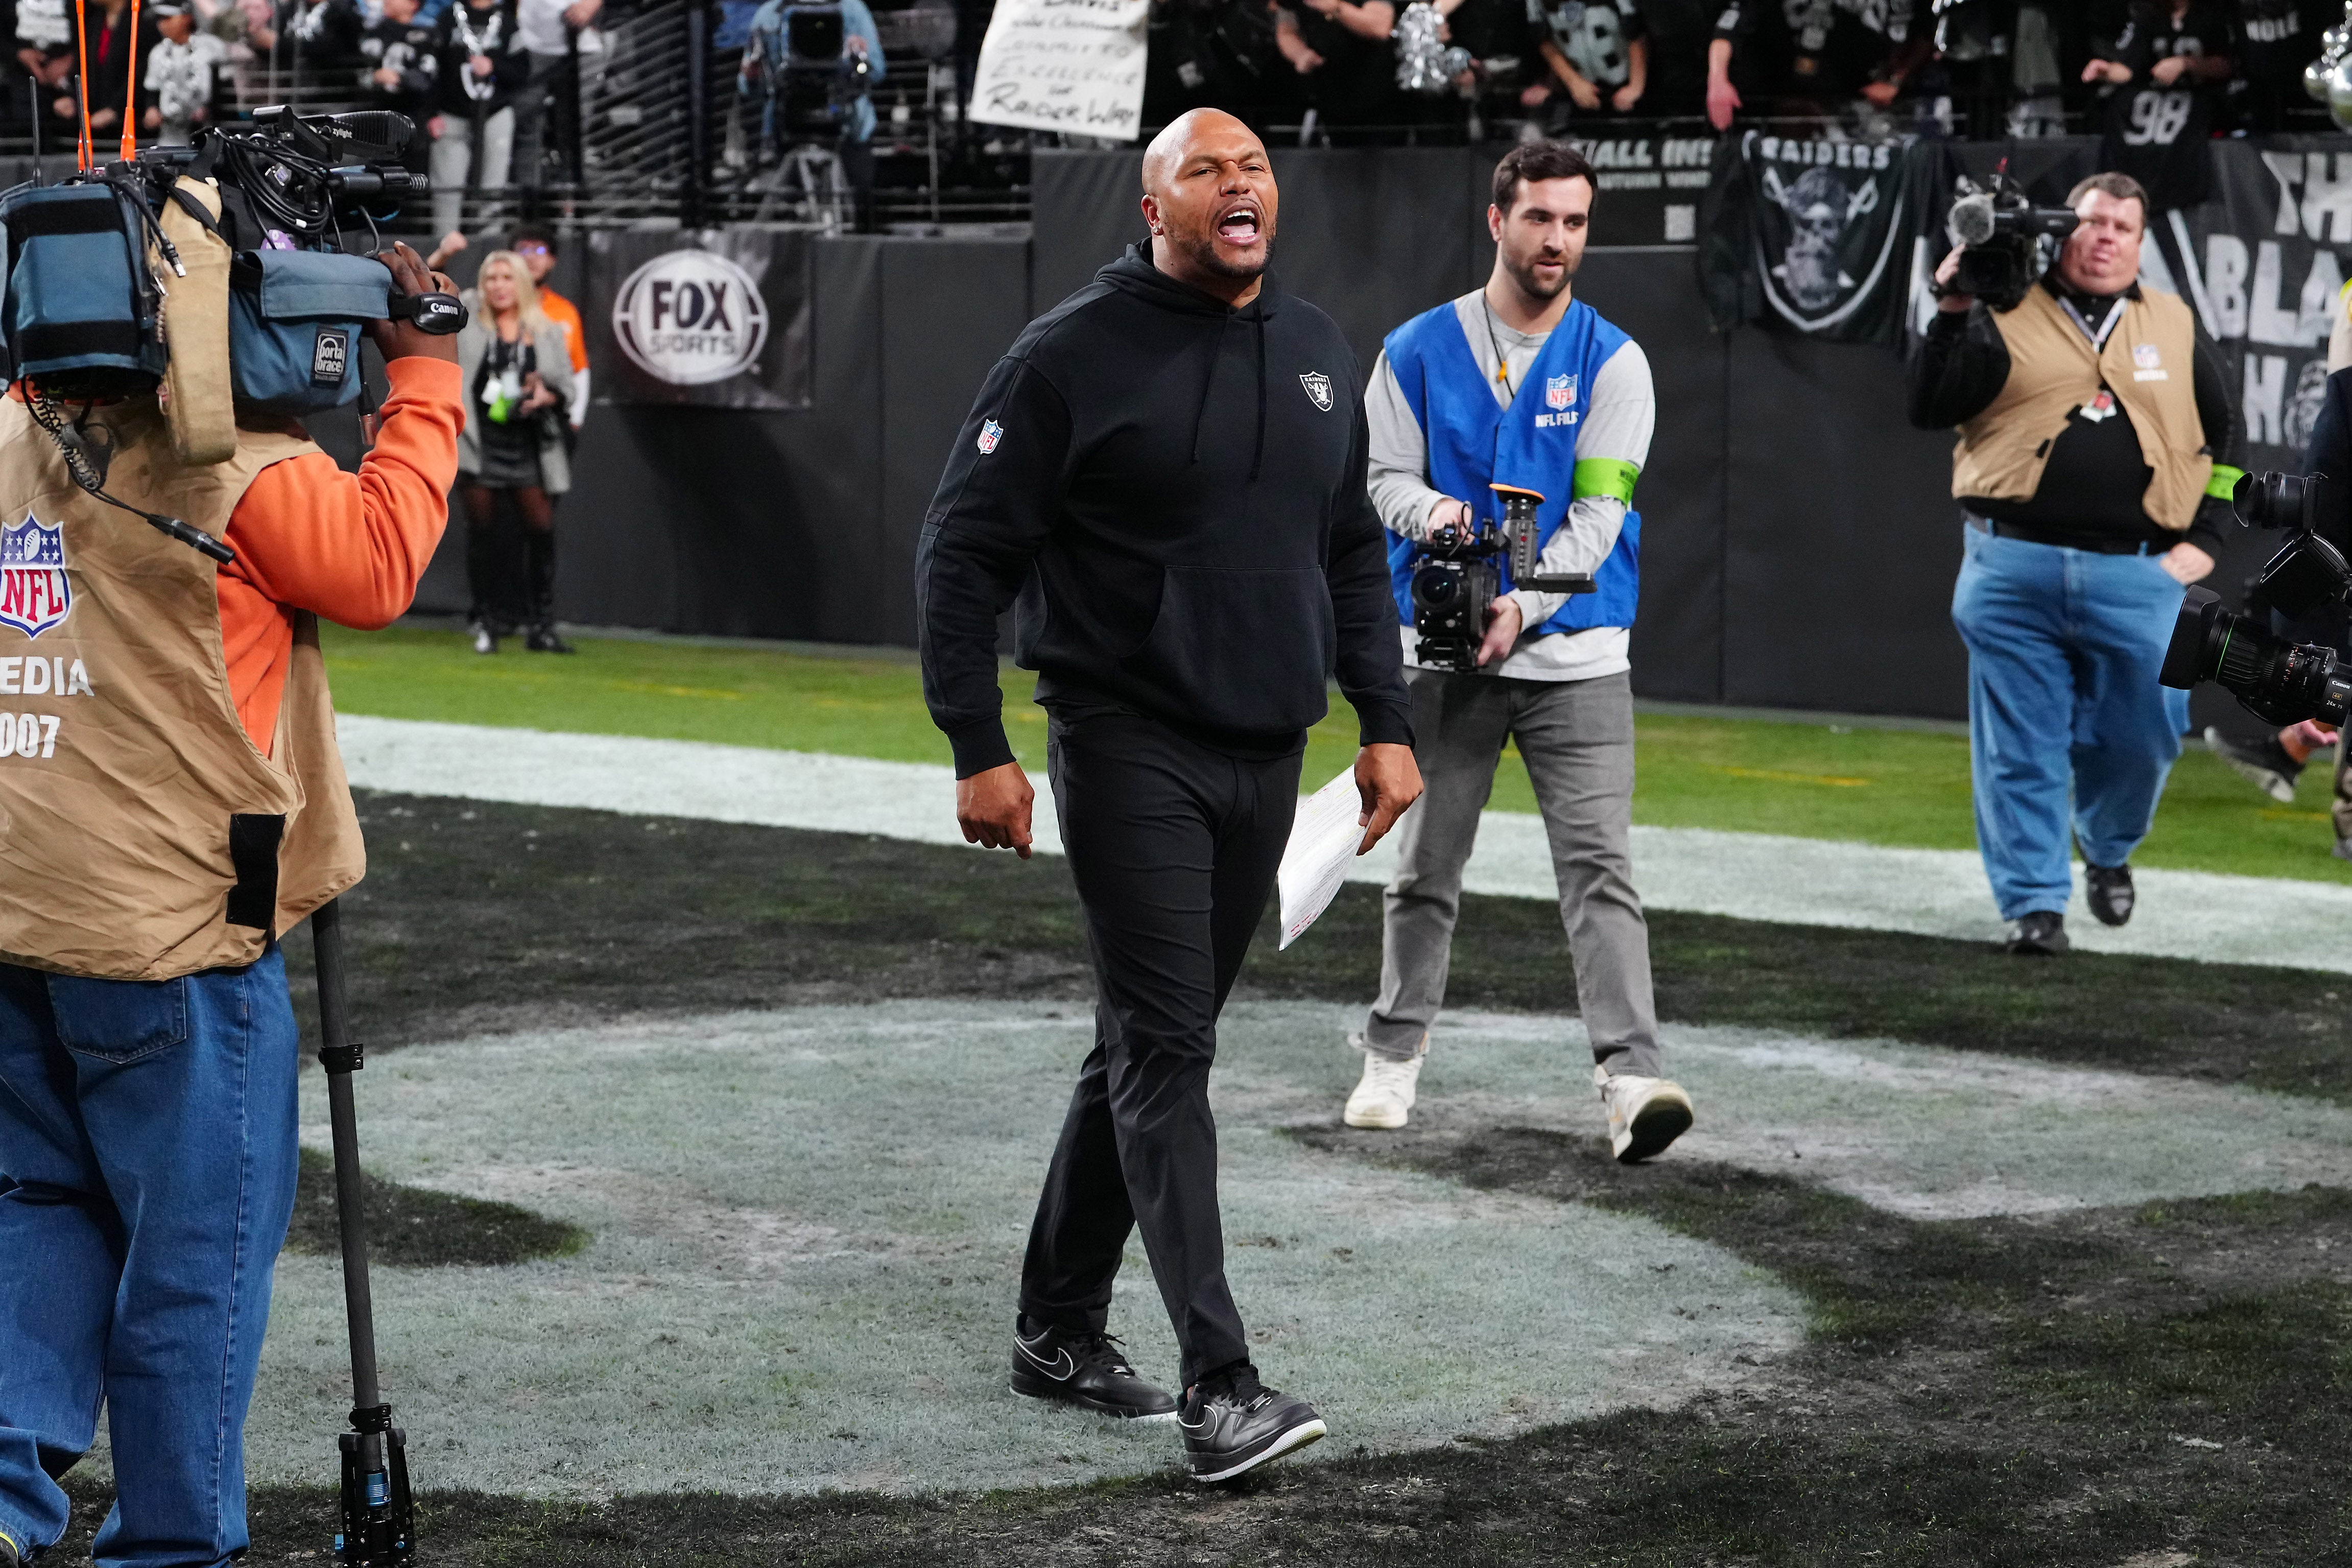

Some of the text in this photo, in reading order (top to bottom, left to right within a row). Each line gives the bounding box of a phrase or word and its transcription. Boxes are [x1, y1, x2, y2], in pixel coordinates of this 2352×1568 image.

[2122, 89, 2192, 146] 98
[332, 128, 352, 139] zylight
[1761, 135, 1890, 171] RAIDERS
[430, 302, 458, 315] Canon
[652, 280, 732, 332] FOX
[649, 334, 735, 355] SPORTS
[1550, 388, 1573, 405] NFL
[1535, 413, 1556, 427] NFL
[980, 432, 995, 449] NFL
[1, 569, 63, 623] NFL
[2332, 680, 2350, 690] Canon
